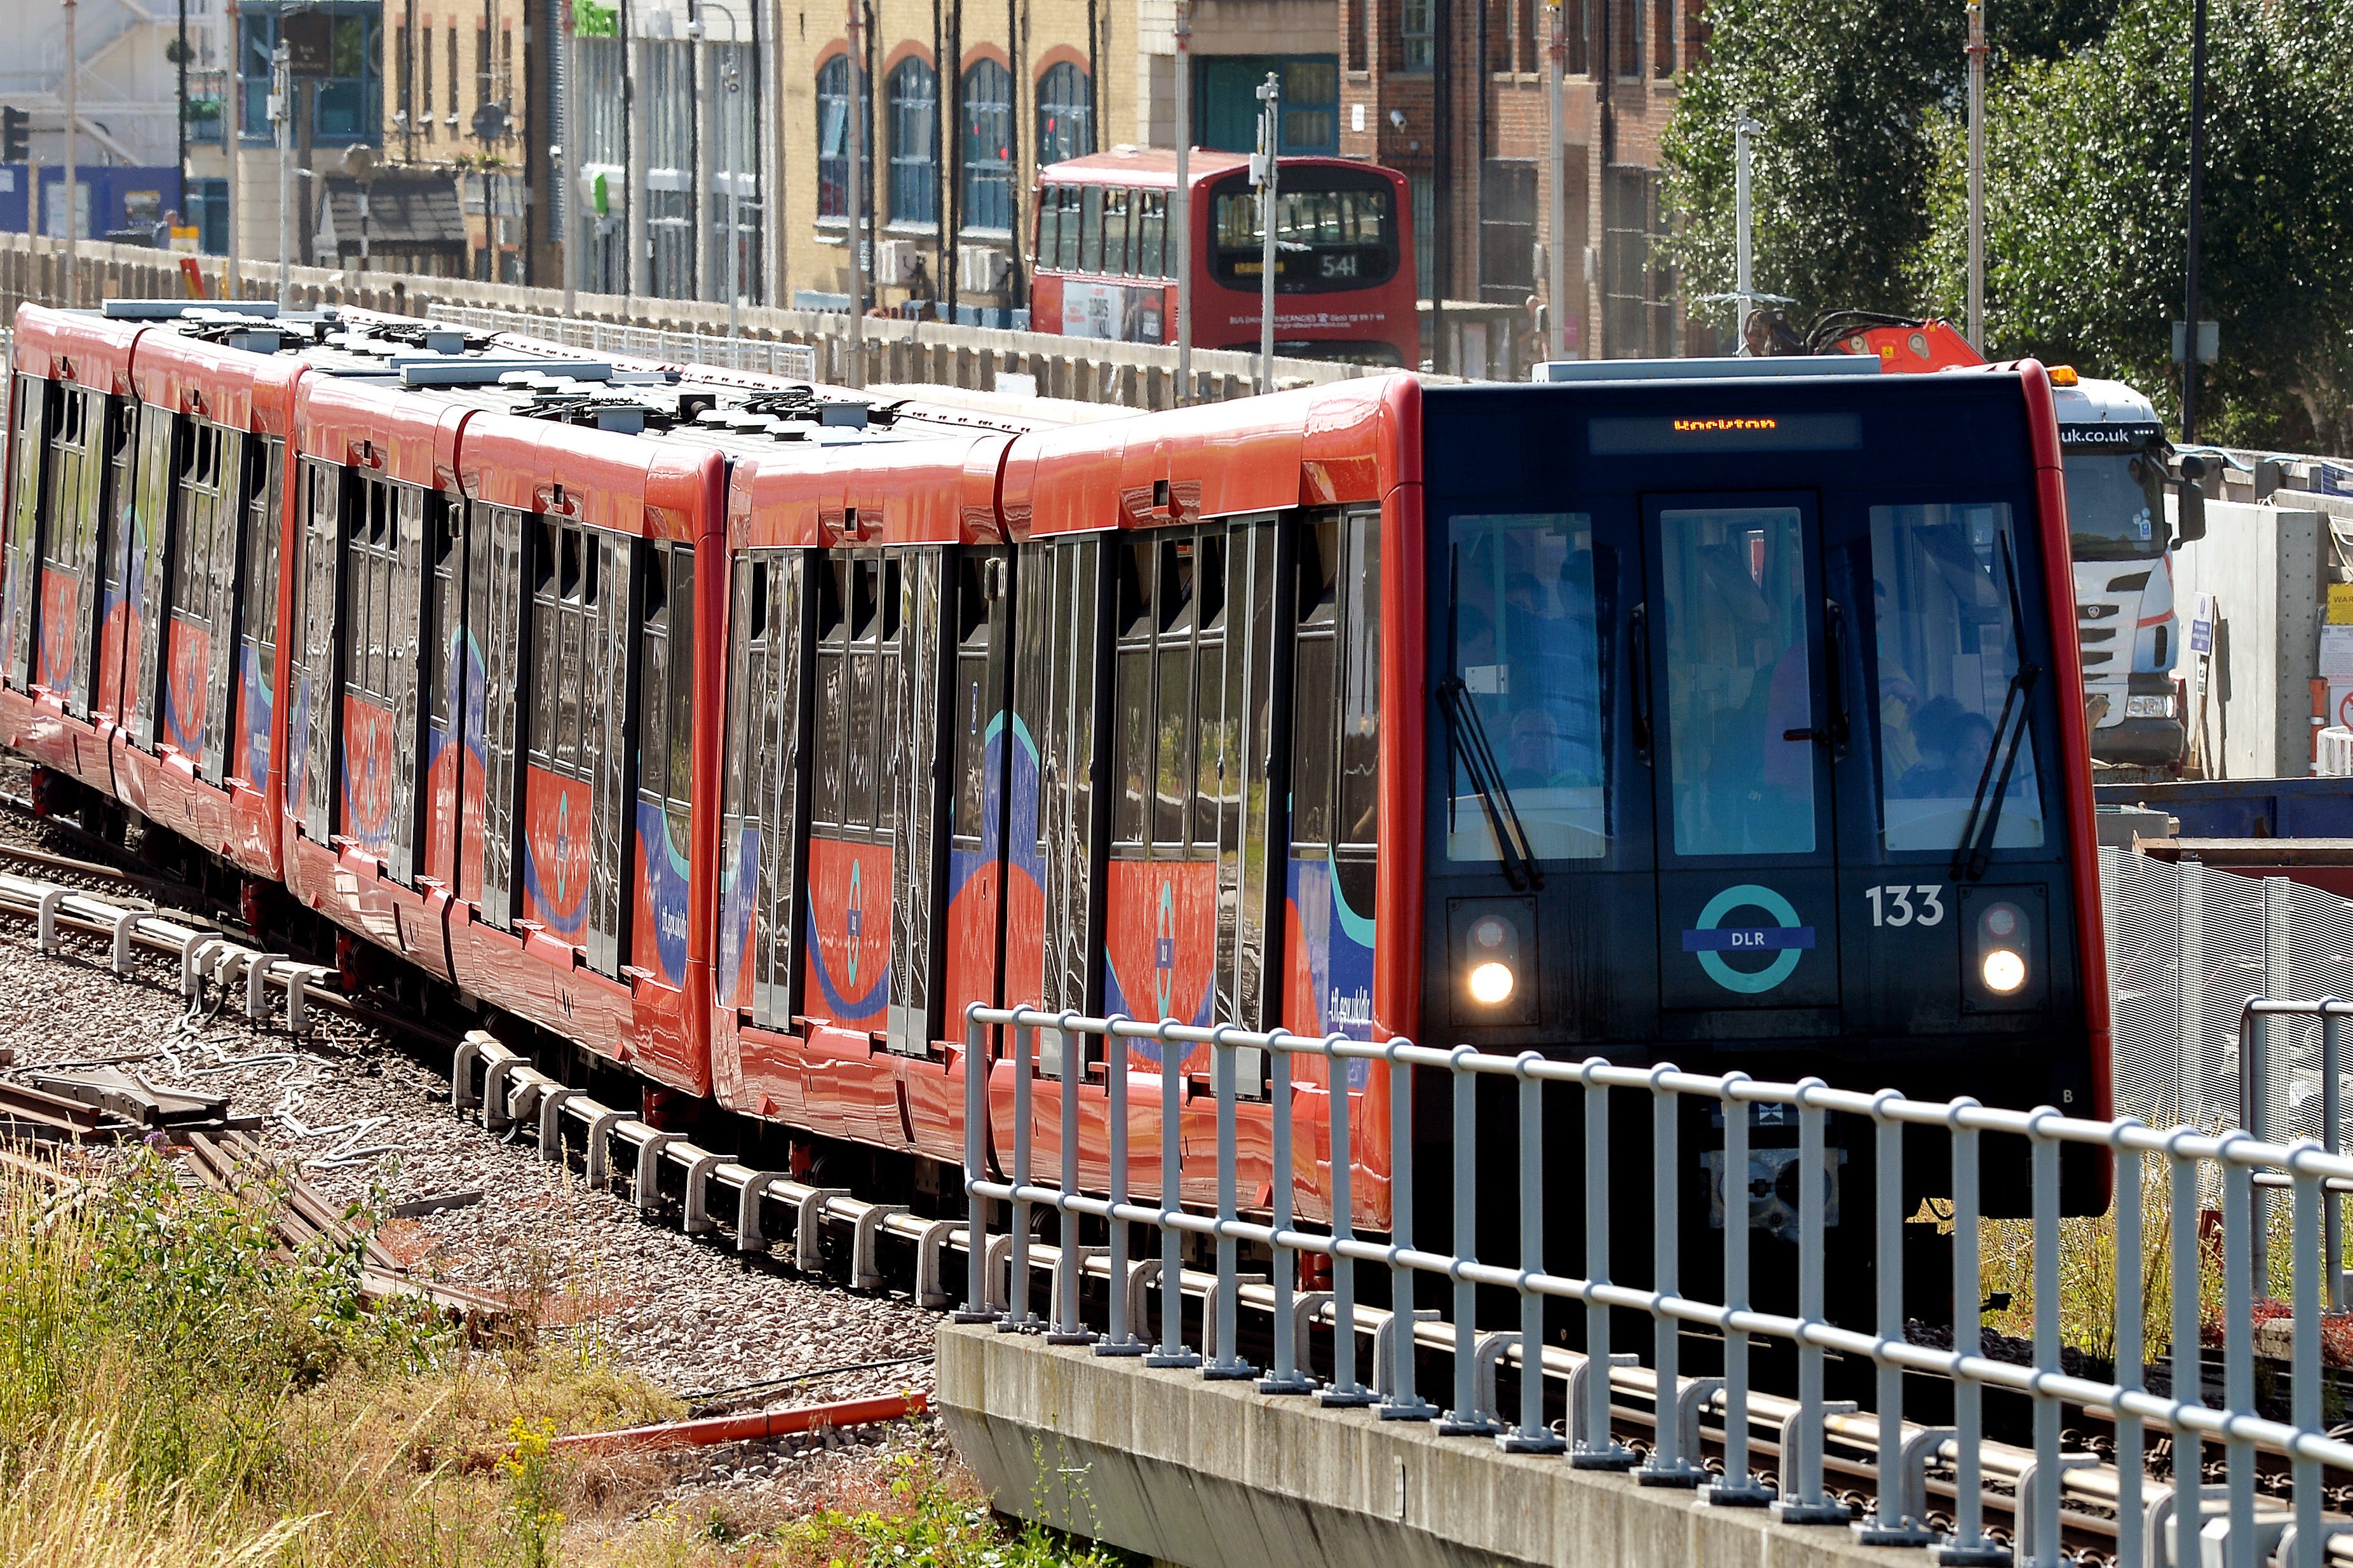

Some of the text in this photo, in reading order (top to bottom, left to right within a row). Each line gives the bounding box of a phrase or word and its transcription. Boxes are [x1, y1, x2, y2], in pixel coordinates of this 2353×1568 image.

[1321, 255, 1357, 277] 541
[1866, 884, 1944, 927] 133
[1732, 932, 1765, 946] DLR
[2063, 1089, 2073, 1103] B
